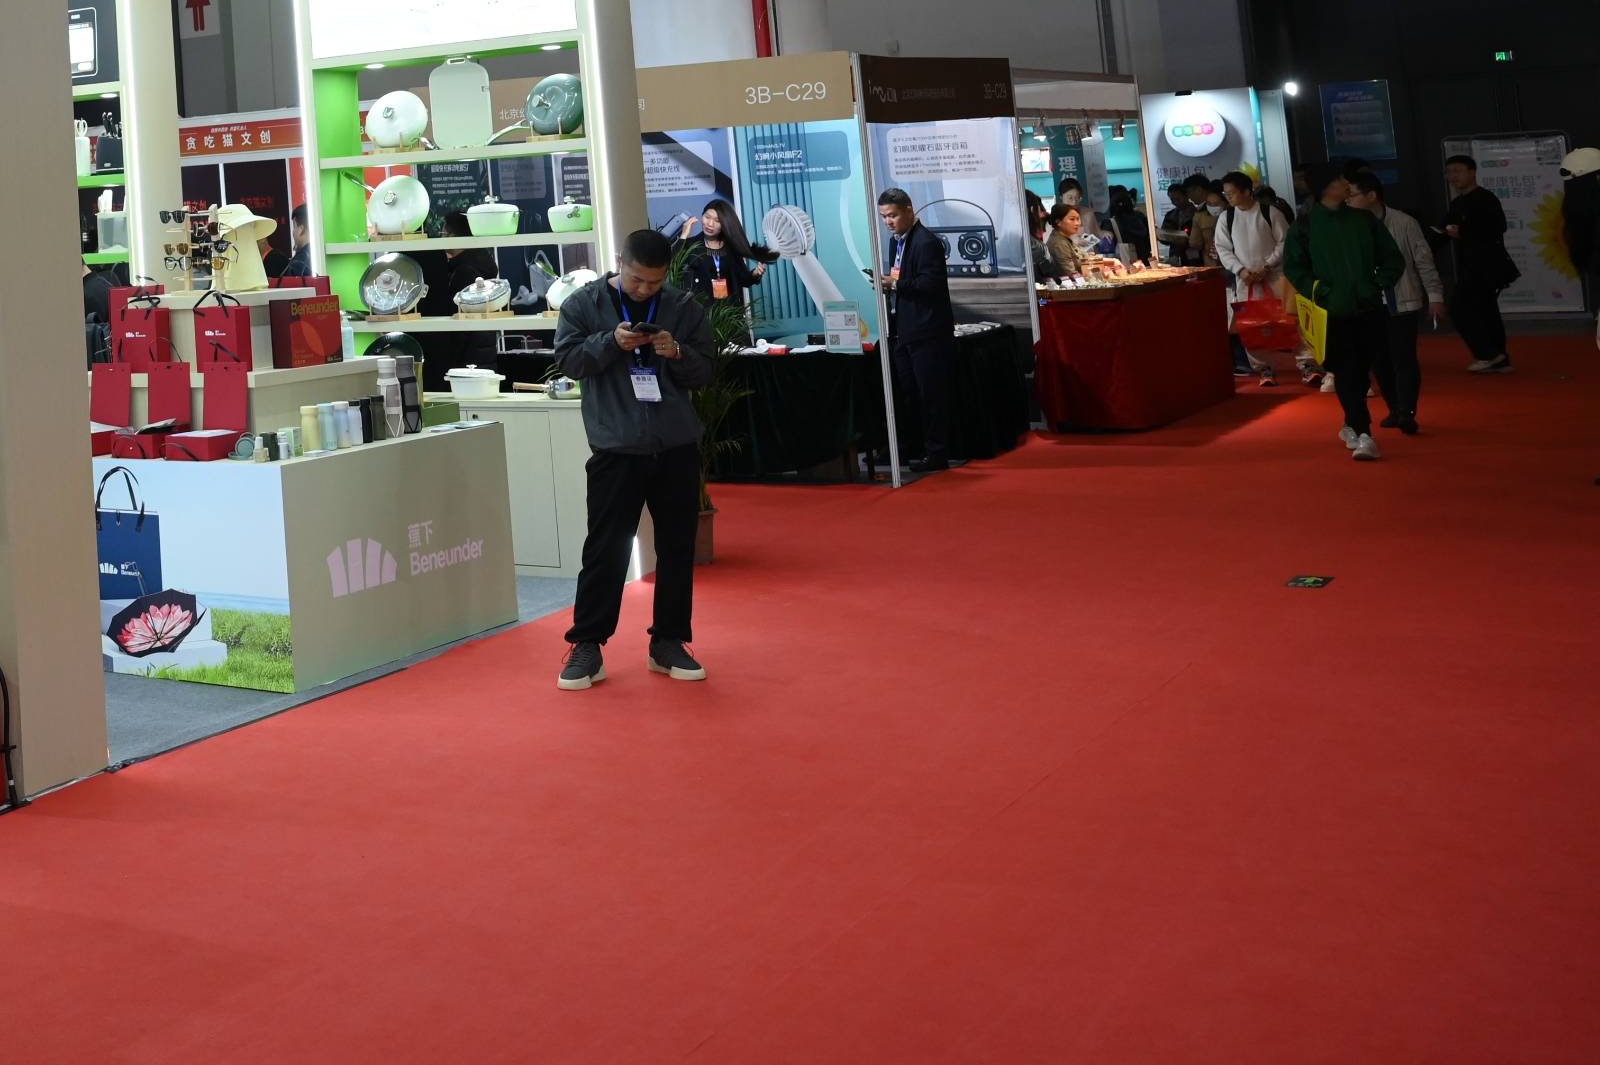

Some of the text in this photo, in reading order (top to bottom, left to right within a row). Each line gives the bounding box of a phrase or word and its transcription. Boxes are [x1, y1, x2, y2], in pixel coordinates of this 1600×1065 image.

[744, 80, 828, 106] 3B-C29
[185, 130, 272, 151] 贪吃猫文创
[290, 296, 341, 317] Beneunder
[407, 519, 434, 549] 蕉下
[409, 538, 484, 577] Beneunder
